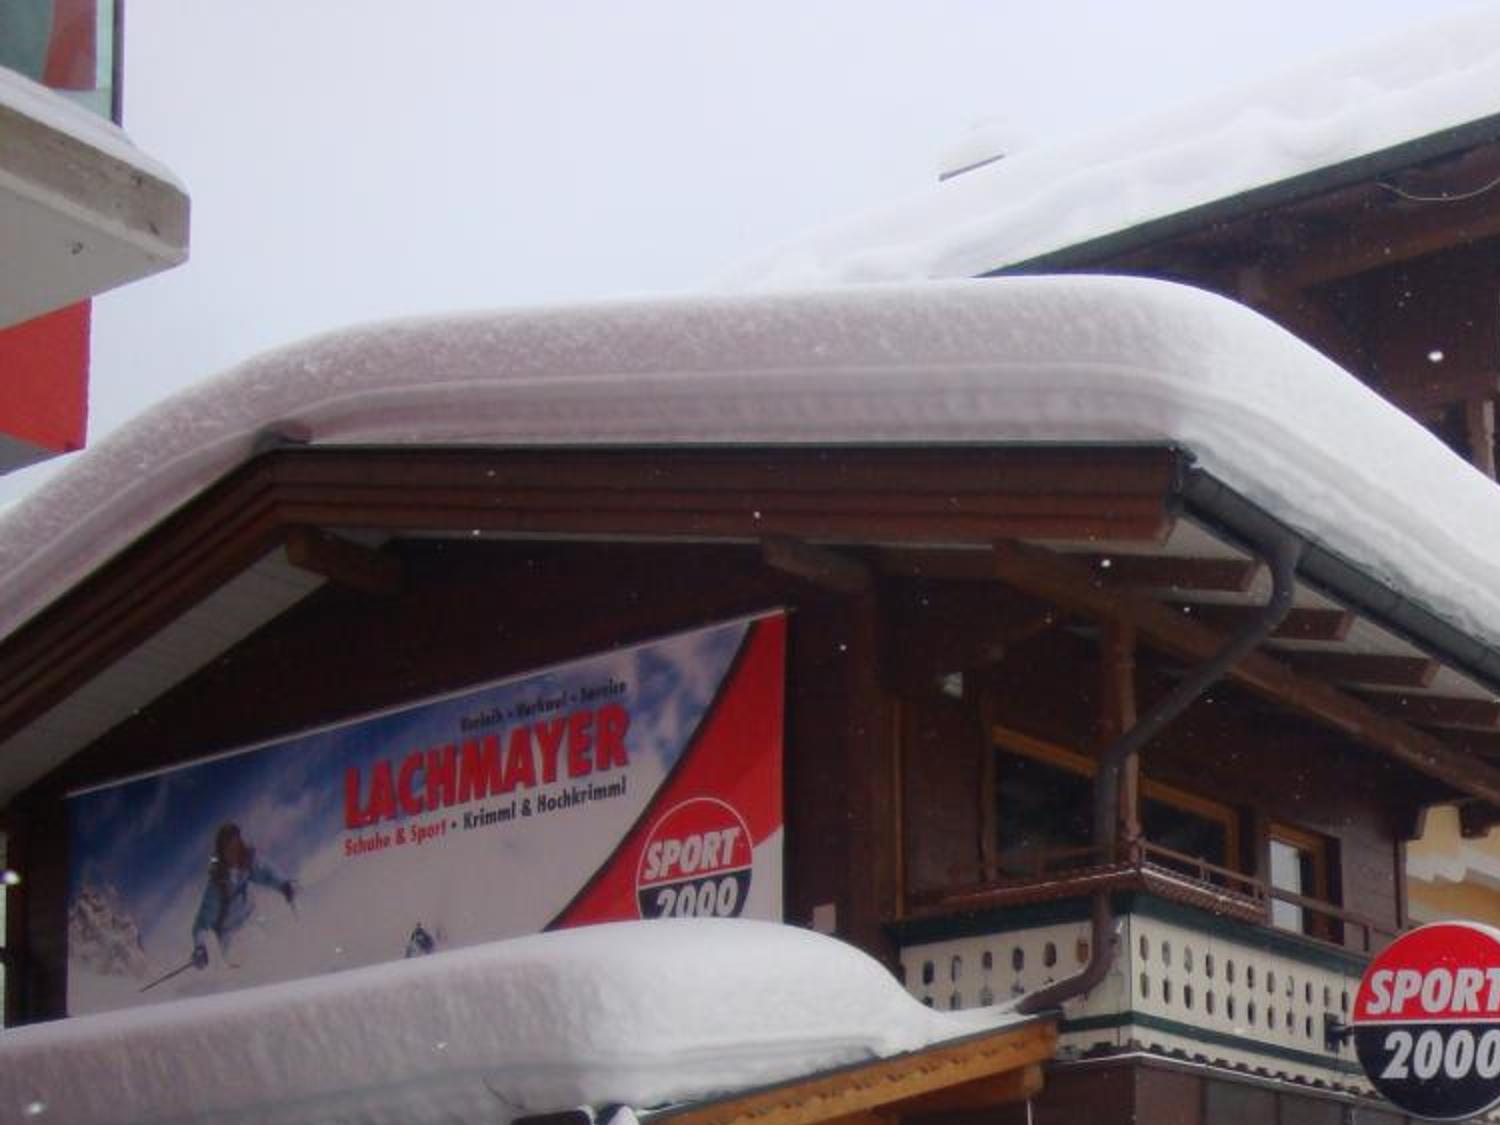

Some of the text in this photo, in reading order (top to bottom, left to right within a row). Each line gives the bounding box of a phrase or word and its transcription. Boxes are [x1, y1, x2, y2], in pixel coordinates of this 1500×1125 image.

[344, 703, 630, 831] LACHMAYER
[344, 775, 627, 857] Schuhe & Sport Krimml & Hochkrimml
[643, 826, 740, 880] SPORT
[657, 877, 738, 918] 2000
